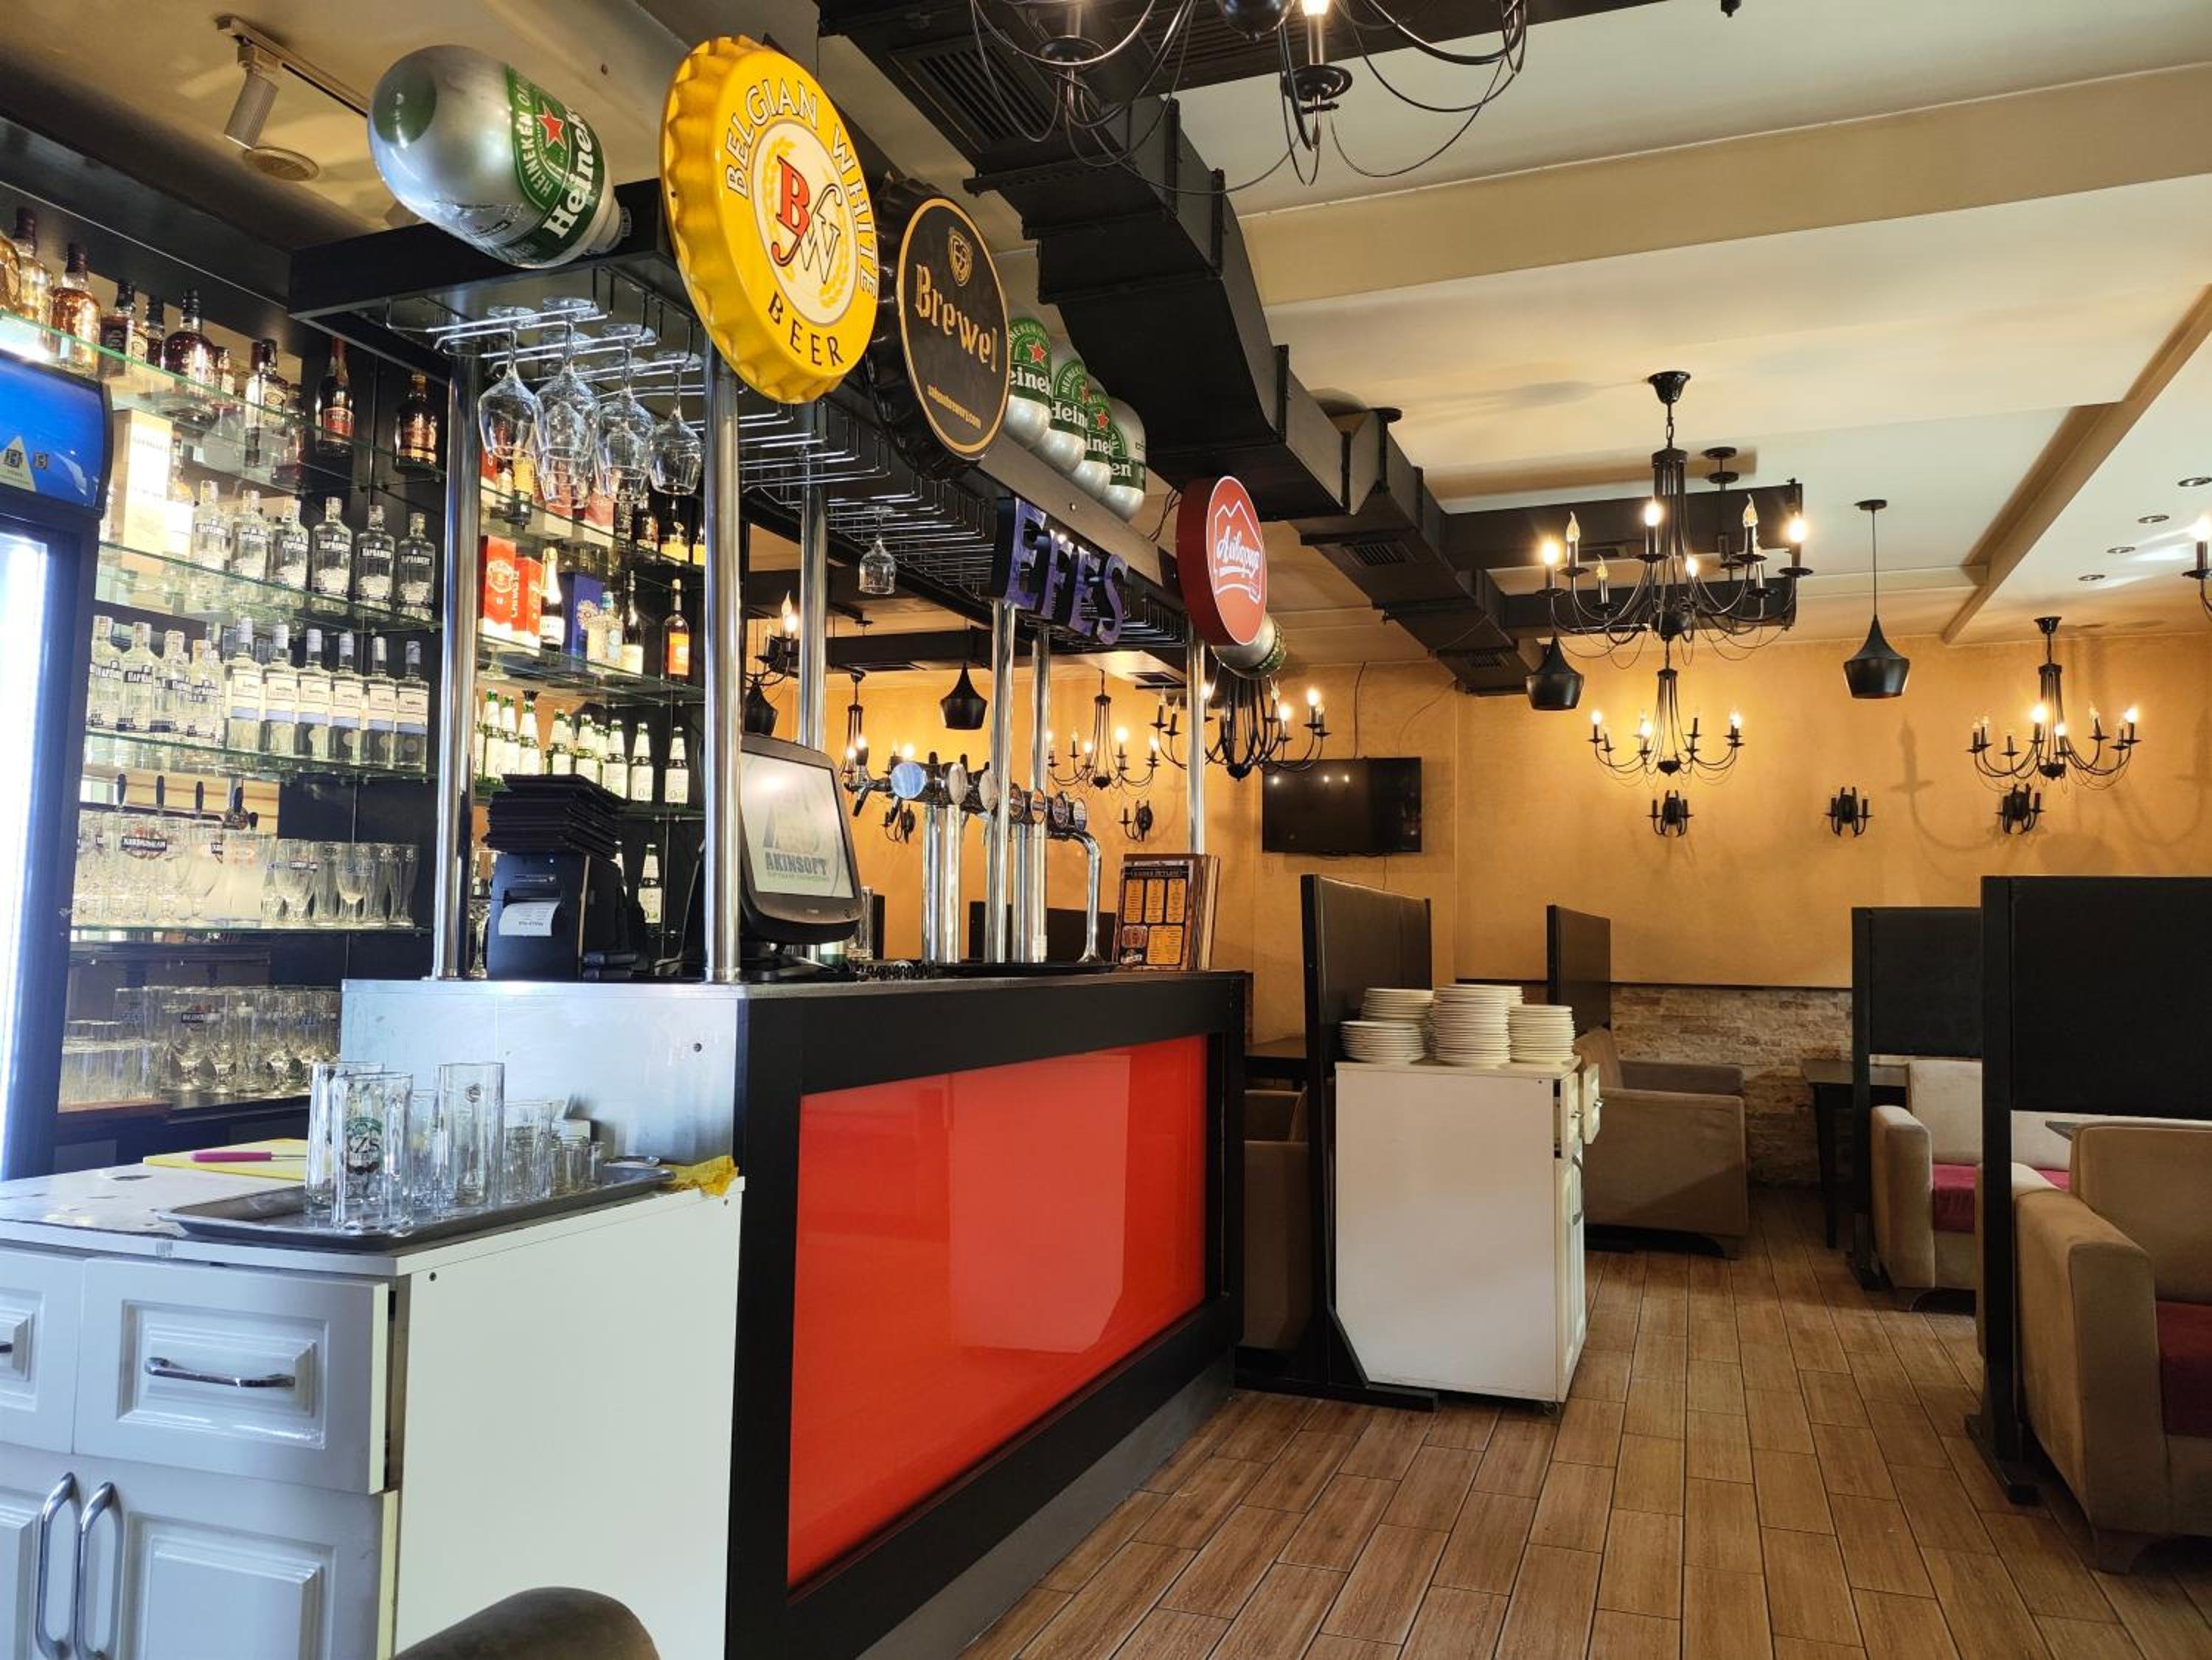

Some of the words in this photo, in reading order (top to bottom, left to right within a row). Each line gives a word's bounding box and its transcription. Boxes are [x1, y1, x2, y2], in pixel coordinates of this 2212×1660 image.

[517, 111, 554, 198] HEINEKEN
[726, 77, 818, 199] BELGIAN
[832, 123, 877, 299] WHITE
[768, 291, 844, 367] BEER
[1004, 497, 1128, 646] EFES
[765, 851, 827, 876] AKINSOFT
